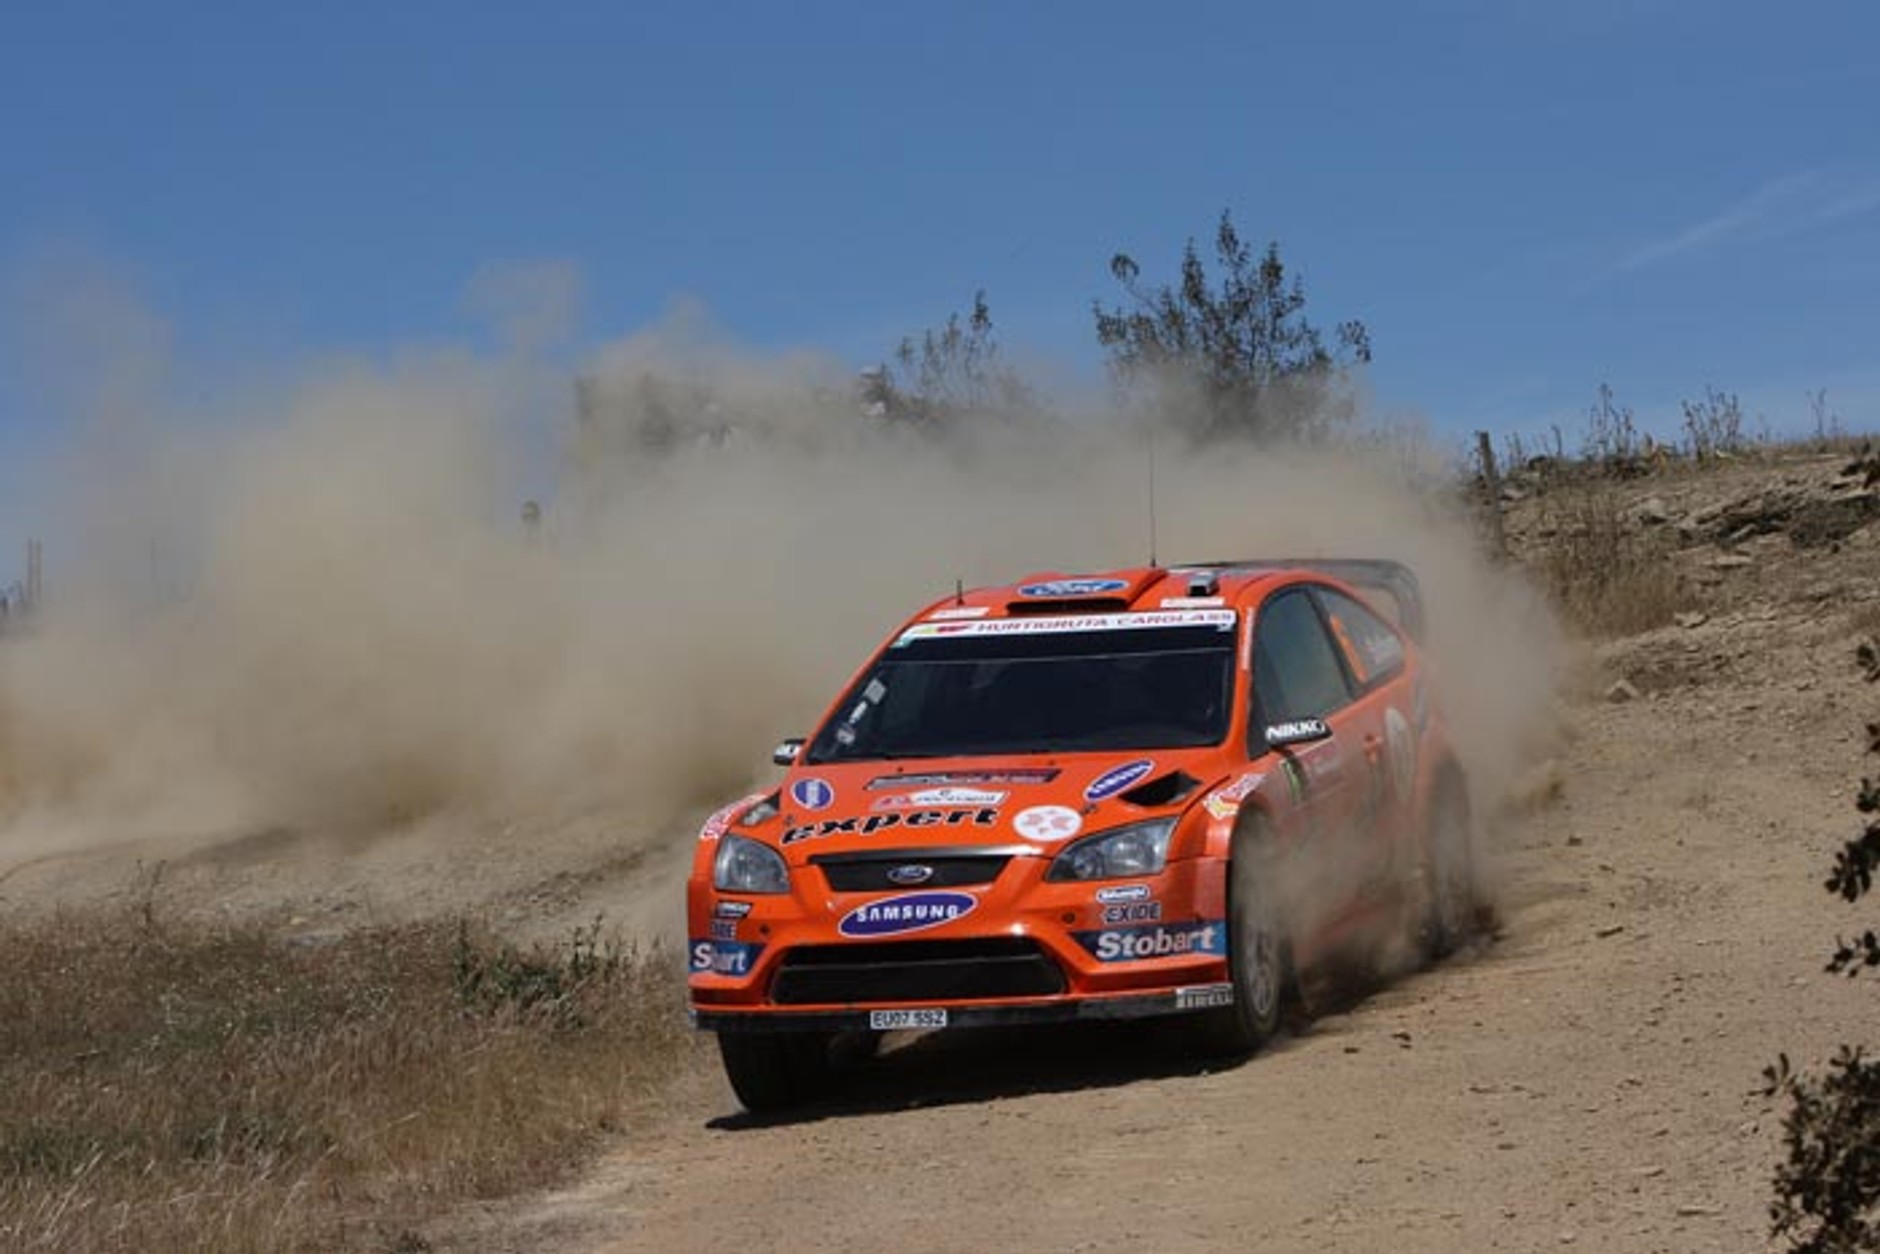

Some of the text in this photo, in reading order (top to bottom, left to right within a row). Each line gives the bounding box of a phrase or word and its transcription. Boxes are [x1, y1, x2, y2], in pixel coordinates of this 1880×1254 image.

[1266, 719, 1326, 741] NIKKO
[781, 808, 997, 845] expert
[856, 904, 959, 923] SAMSUNG
[1096, 926, 1215, 961] Stobart
